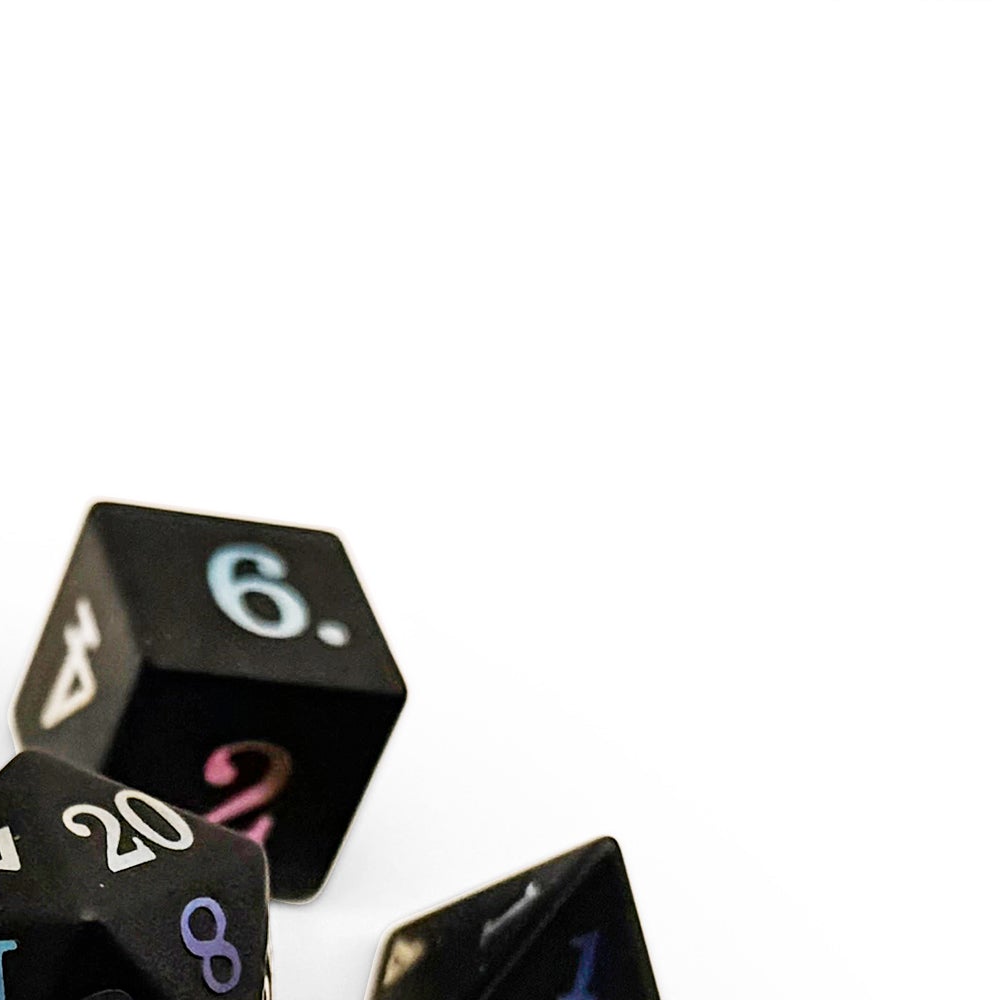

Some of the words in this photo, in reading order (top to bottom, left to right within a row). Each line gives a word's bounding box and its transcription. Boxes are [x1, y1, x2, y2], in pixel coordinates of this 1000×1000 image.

[40, 597, 101, 729] 4
[63, 789, 195, 873] 20
[203, 741, 293, 843] 2
[180, 897, 242, 994] 8
